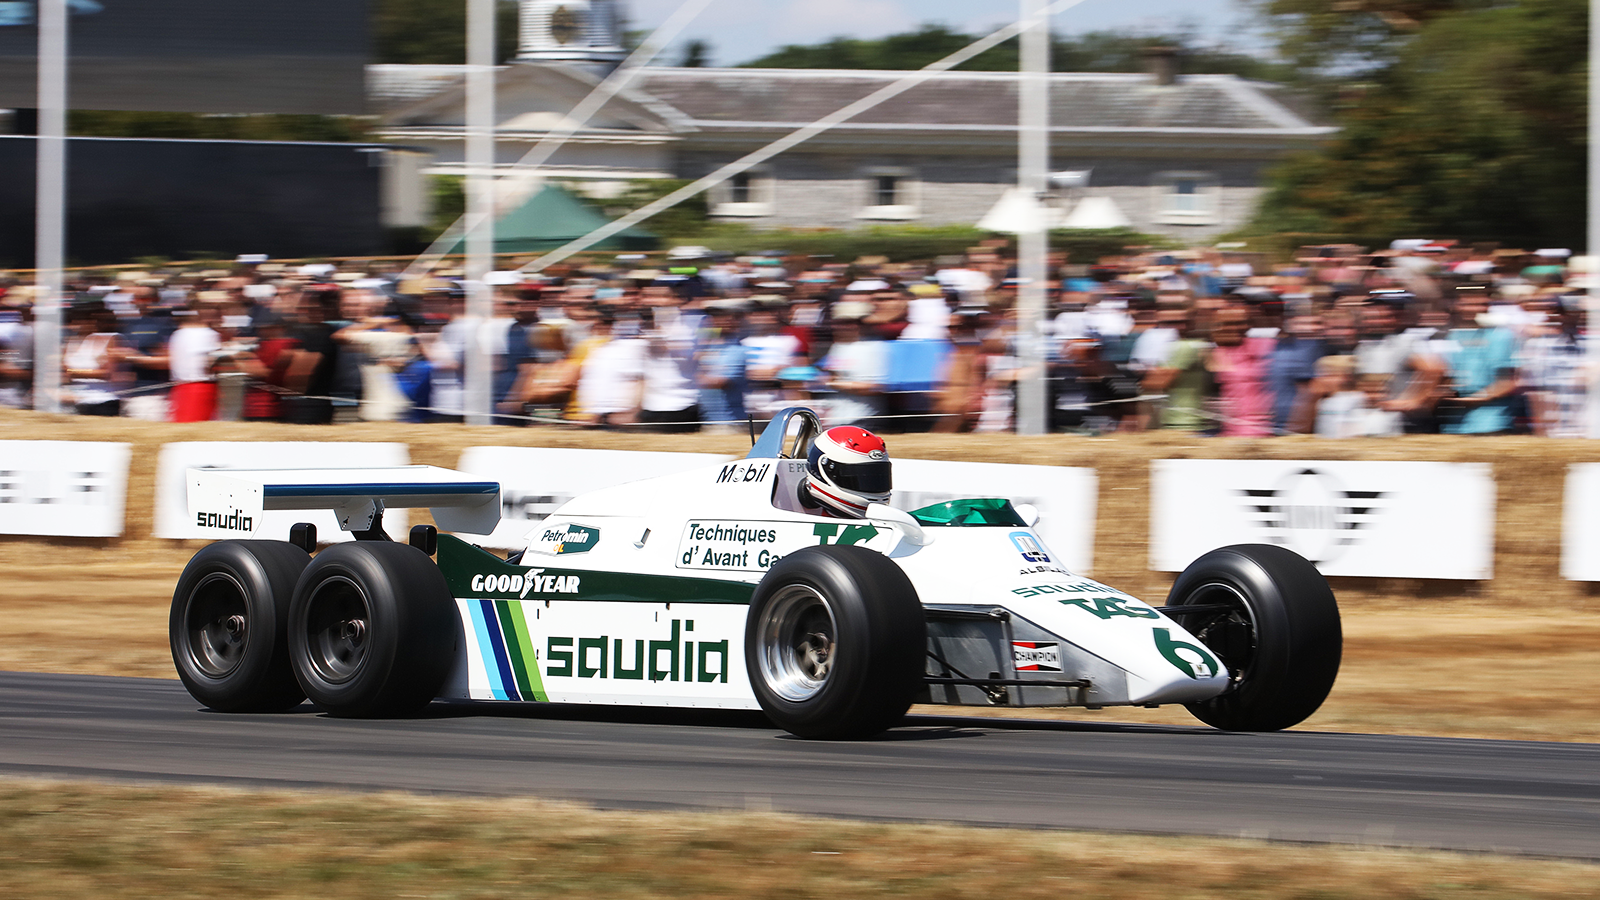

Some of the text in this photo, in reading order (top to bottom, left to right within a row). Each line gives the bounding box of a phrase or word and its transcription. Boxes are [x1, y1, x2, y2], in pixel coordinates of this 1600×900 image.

[716, 463, 770, 483] Mobil
[788, 463, 795, 473] E
[197, 509, 252, 531] saudia
[541, 529, 590, 543] Petromin
[689, 524, 776, 545] Techniques
[702, 548, 748, 567] Avant
[547, 619, 728, 683] saudia
[1014, 650, 1059, 662] CHAMPION
[1152, 627, 1219, 680] 6
